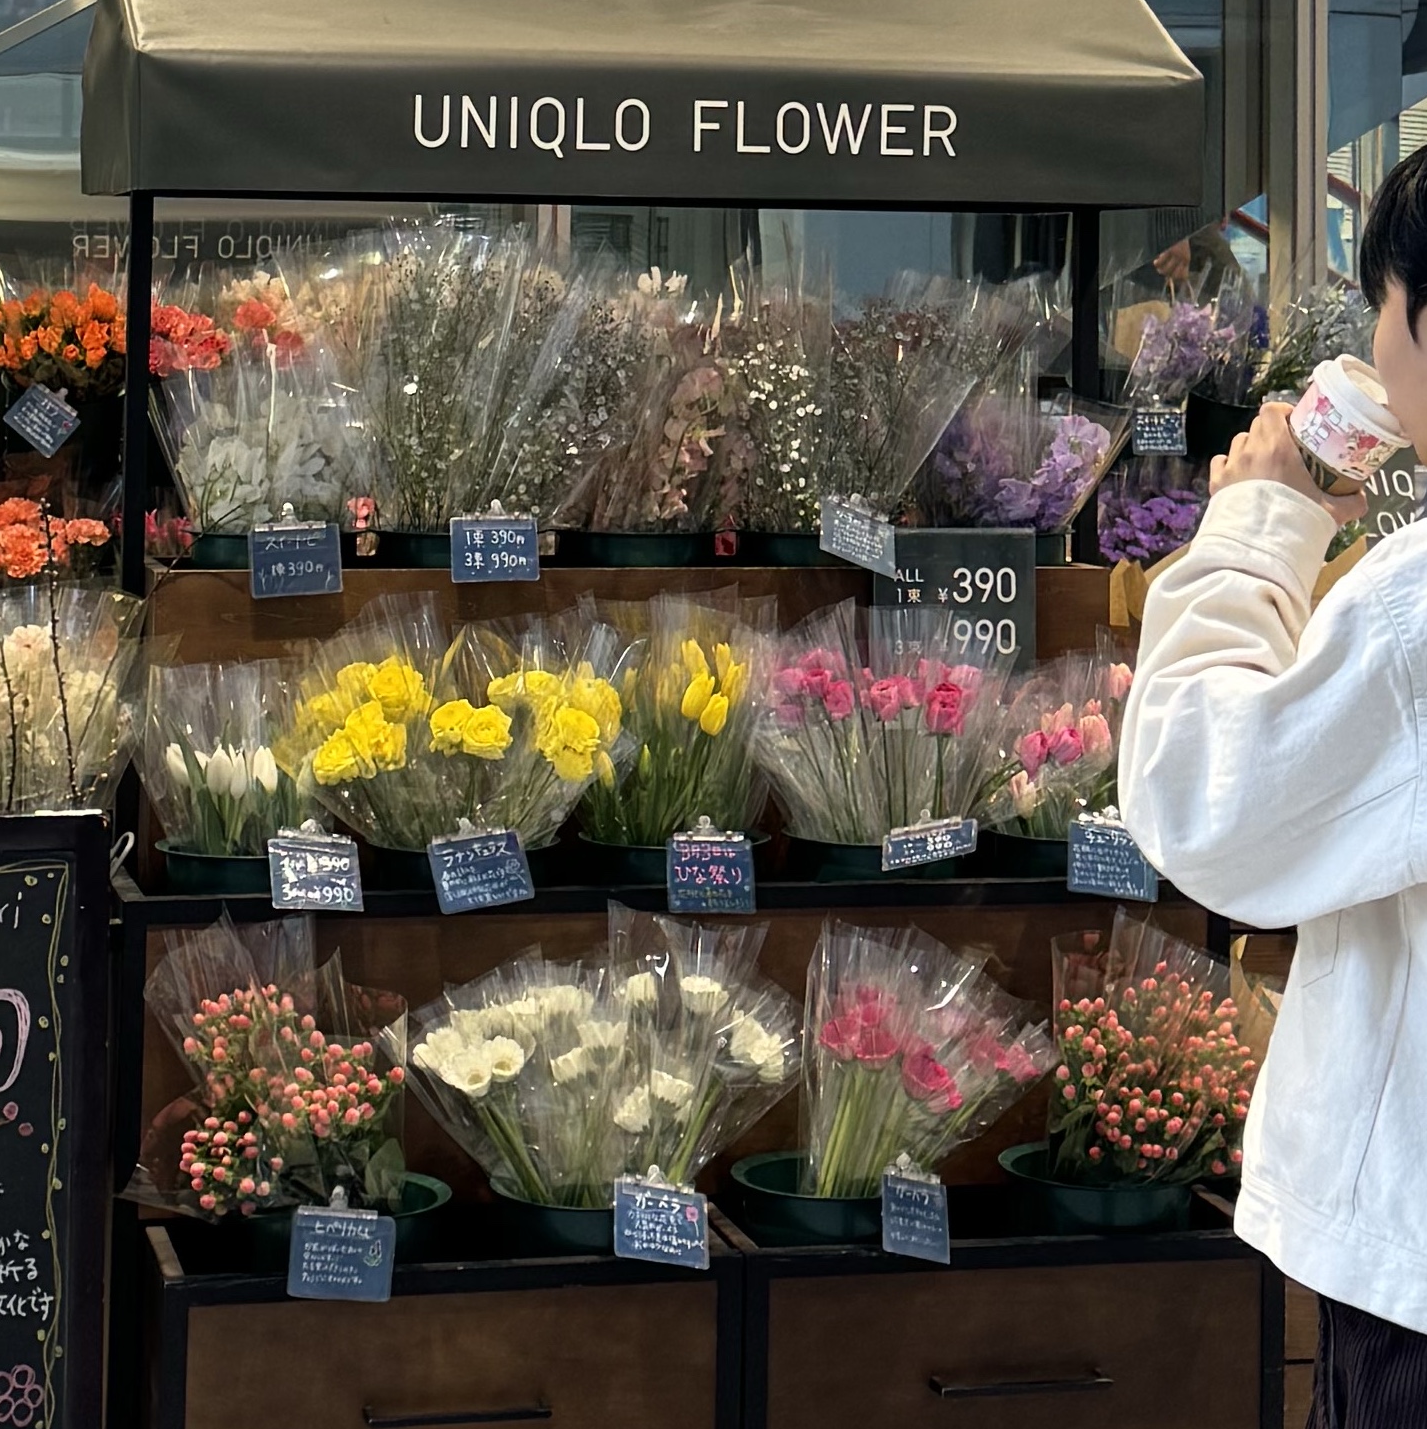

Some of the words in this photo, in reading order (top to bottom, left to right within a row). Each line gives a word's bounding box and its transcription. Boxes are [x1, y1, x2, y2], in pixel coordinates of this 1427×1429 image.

[412, 94, 651, 159] UNIQLO
[693, 100, 958, 157] FLOWER
[893, 568, 924, 583] ALL
[1084, 828, 1136, 847] チューリッ
[443, 841, 512, 867] ラナンキュラス
[674, 864, 742, 885] ひな祭り
[634, 1190, 681, 1213] ガーベラ
[314, 1220, 371, 1239] ヒペリカム
